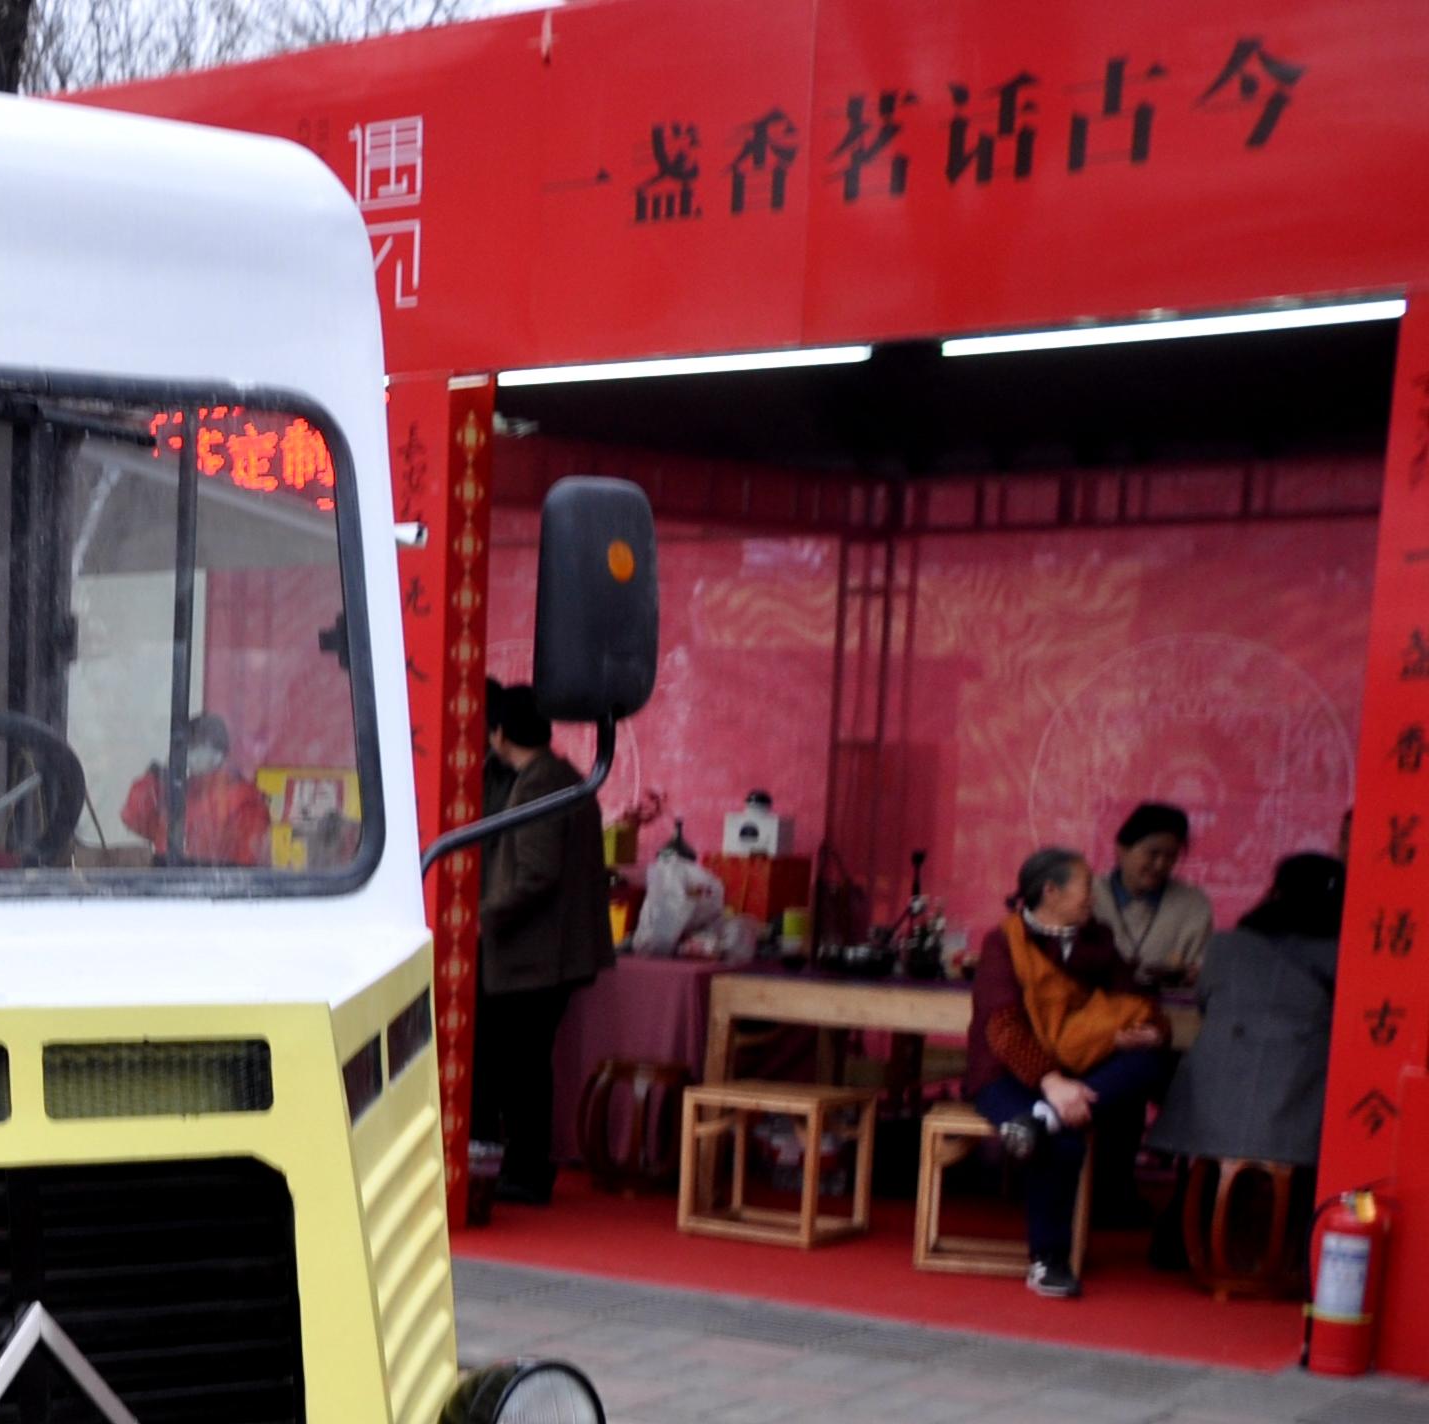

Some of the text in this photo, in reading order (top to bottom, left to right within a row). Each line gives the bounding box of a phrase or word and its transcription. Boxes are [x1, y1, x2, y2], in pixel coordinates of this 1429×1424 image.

[541, 37, 1305, 225] 一盏香茗话古今
